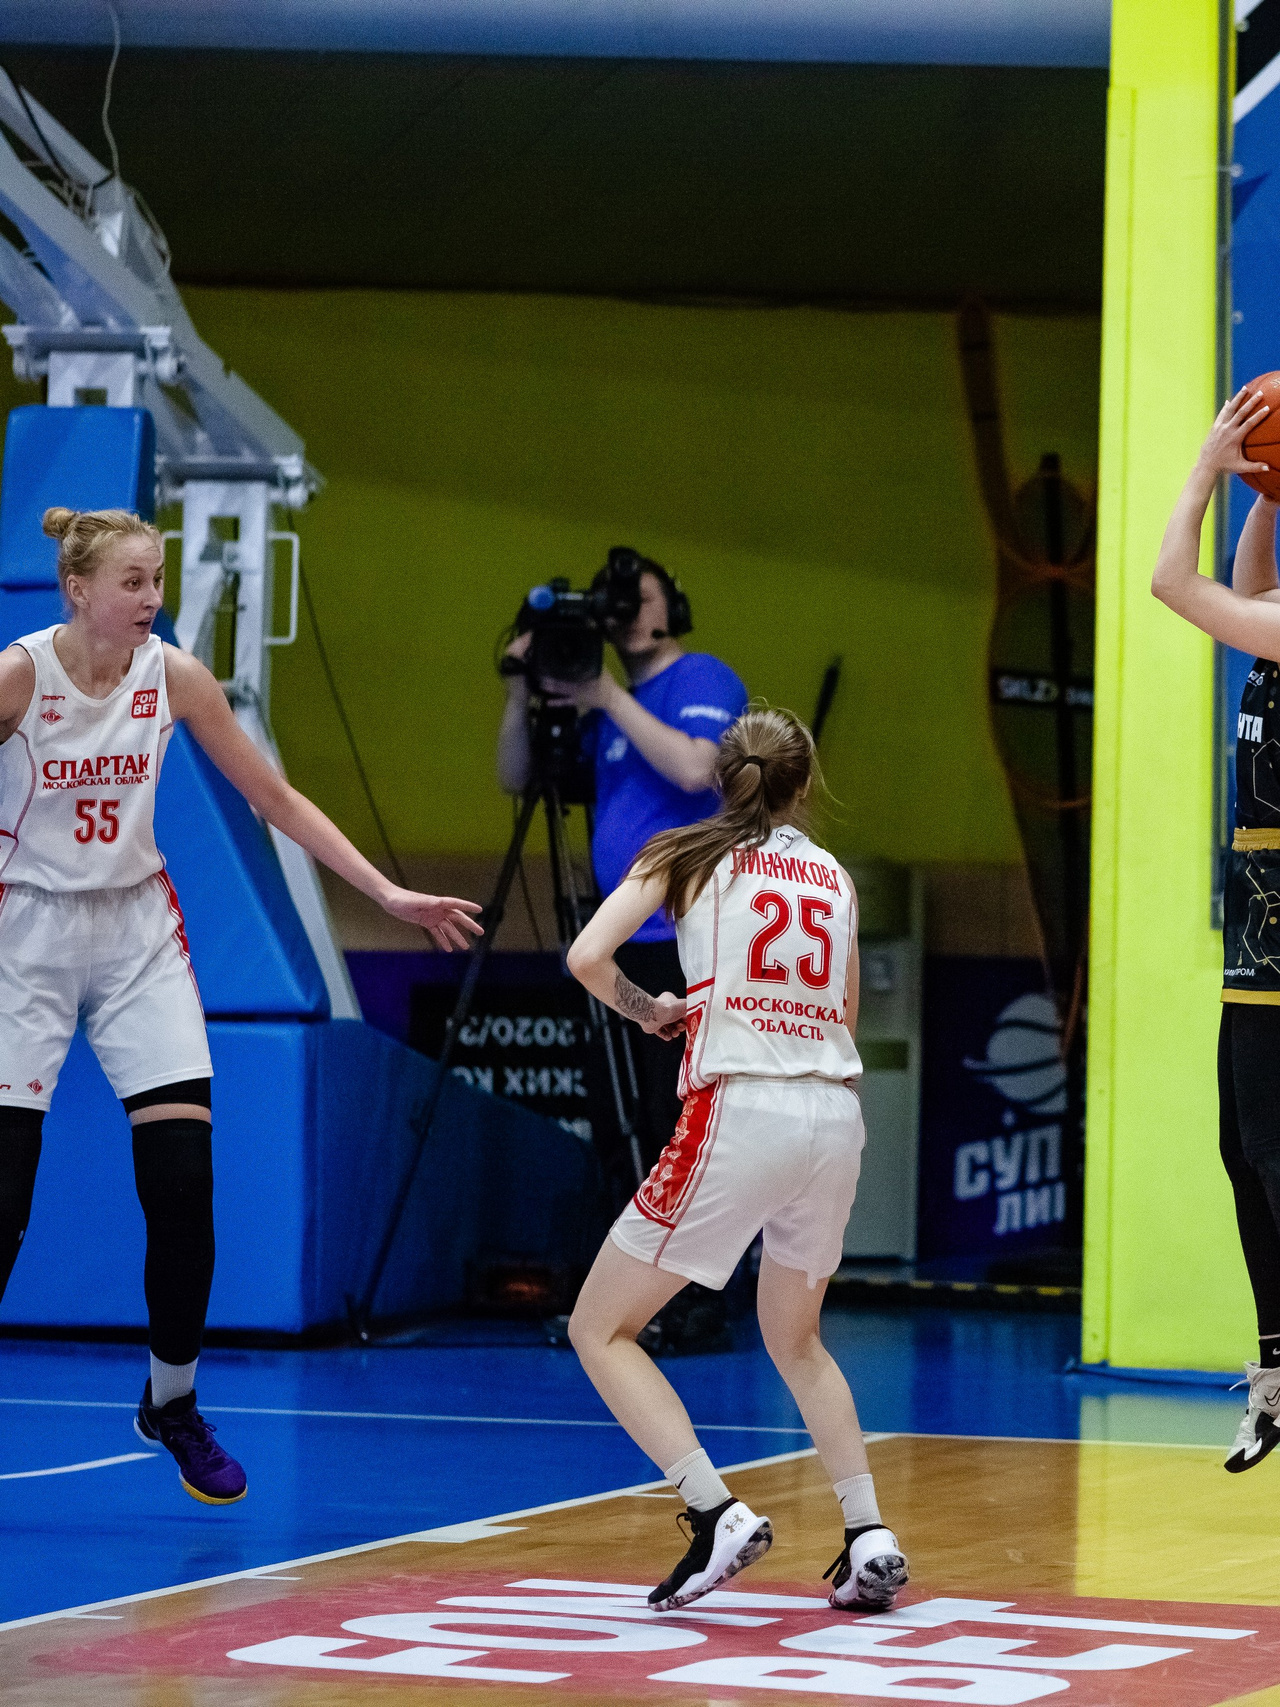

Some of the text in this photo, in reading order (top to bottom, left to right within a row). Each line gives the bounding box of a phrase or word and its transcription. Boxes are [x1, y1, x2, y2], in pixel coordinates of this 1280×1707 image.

[133, 703, 157, 715] BET
[134, 692, 156, 704] FON
[42, 753, 151, 781] СПАРТАК
[42, 777, 111, 790] МОСКОВСКАЯ
[74, 798, 121, 844] 55
[746, 889, 834, 990] 25
[750, 1017, 825, 1042] ОБЛАСТЬ
[953, 1124, 1062, 1201] СУП
[225, 1578, 833, 1684] FON
[646, 1597, 1260, 1706] BET
